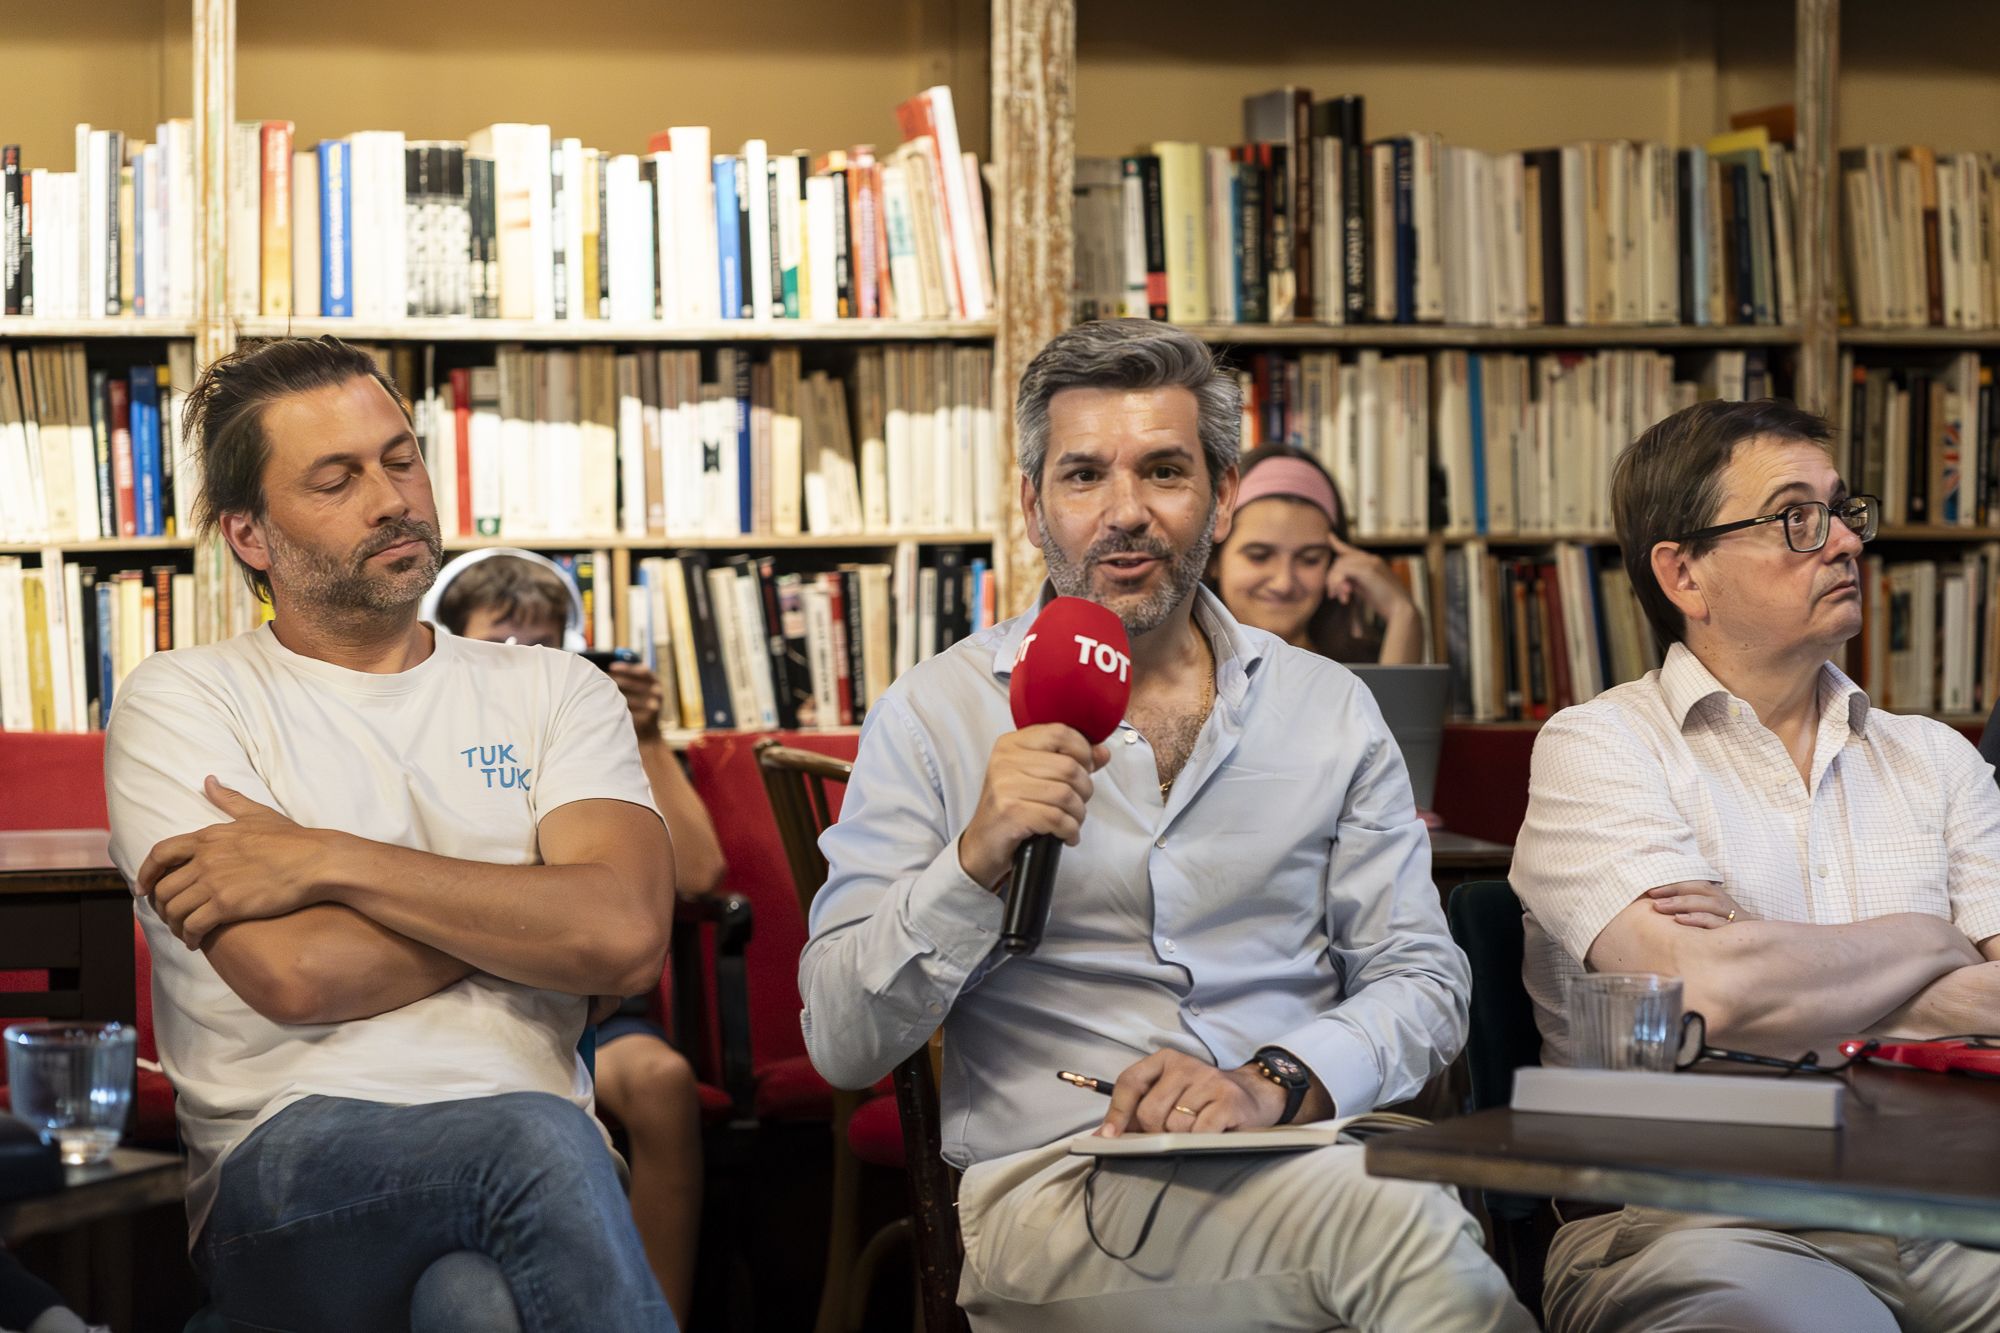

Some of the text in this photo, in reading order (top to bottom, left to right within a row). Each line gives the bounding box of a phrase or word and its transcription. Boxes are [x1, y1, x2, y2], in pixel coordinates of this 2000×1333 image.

[1074, 634, 1130, 683] TOT
[460, 744, 518, 768] TUK
[480, 767, 532, 791] TUK
